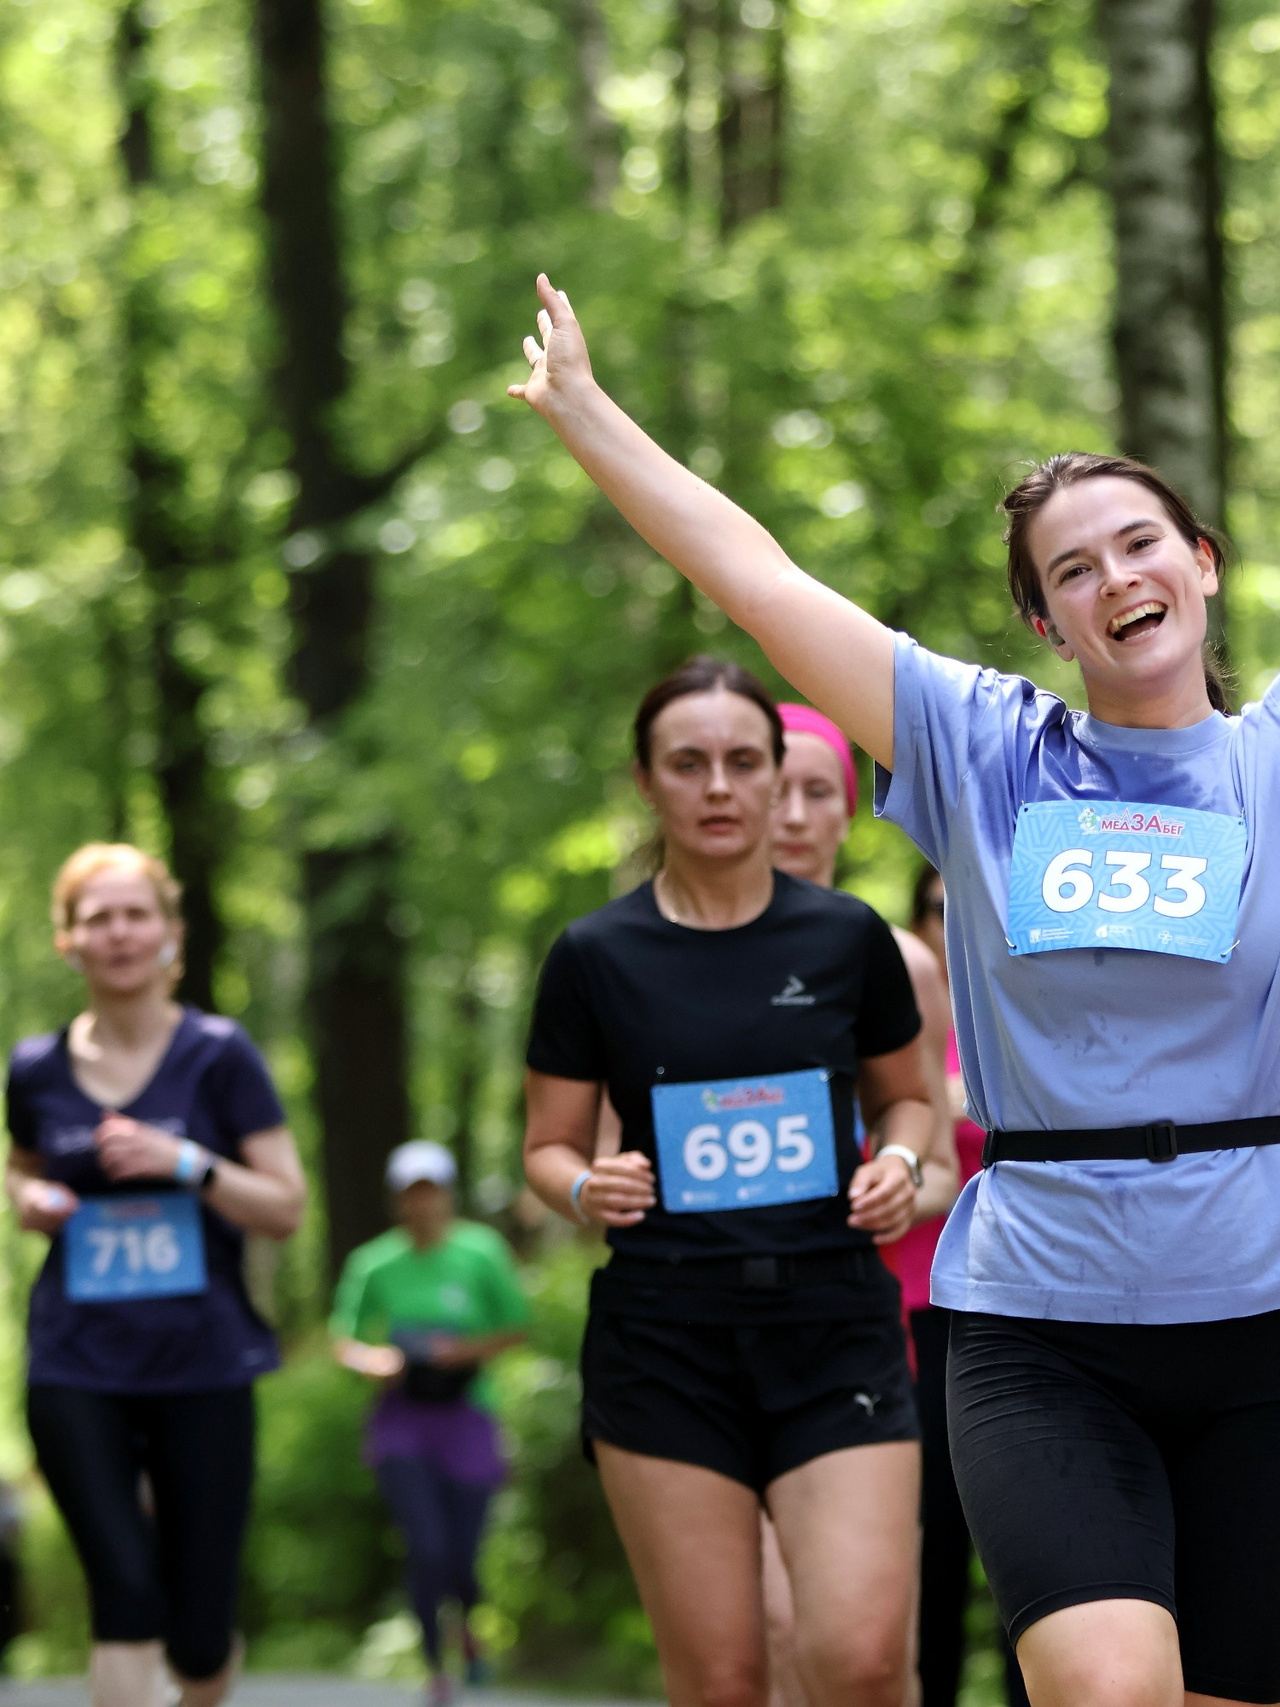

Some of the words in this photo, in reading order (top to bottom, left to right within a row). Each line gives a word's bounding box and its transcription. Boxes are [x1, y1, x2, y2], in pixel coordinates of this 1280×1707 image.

[1101, 813, 1184, 835] МЕДЗАБЕГ
[1041, 848, 1208, 918] 633
[683, 1114, 815, 1182] 695
[87, 1222, 181, 1277] 716
